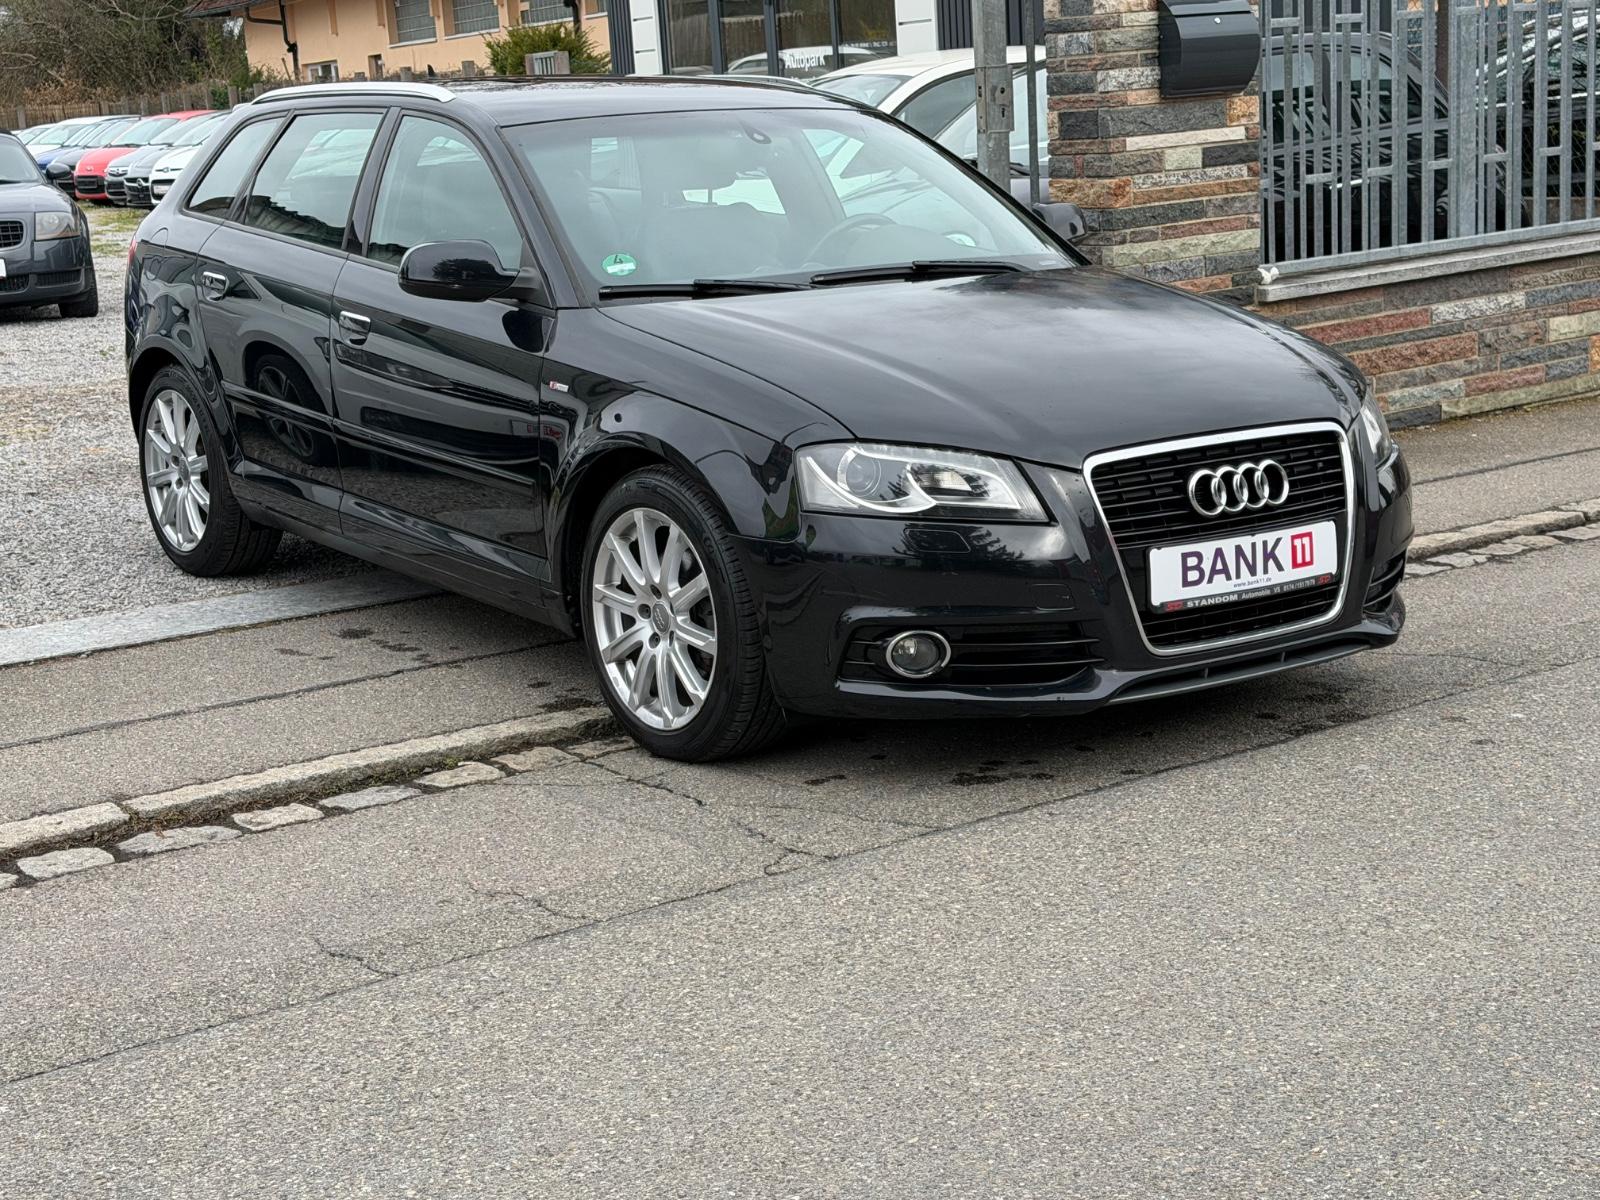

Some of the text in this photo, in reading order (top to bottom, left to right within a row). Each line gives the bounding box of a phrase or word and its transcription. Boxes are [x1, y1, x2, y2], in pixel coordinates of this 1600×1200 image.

[785, 51, 825, 71] Autopark
[1181, 535, 1311, 588] BANK 11
[1187, 594, 1238, 608] STANDOM
